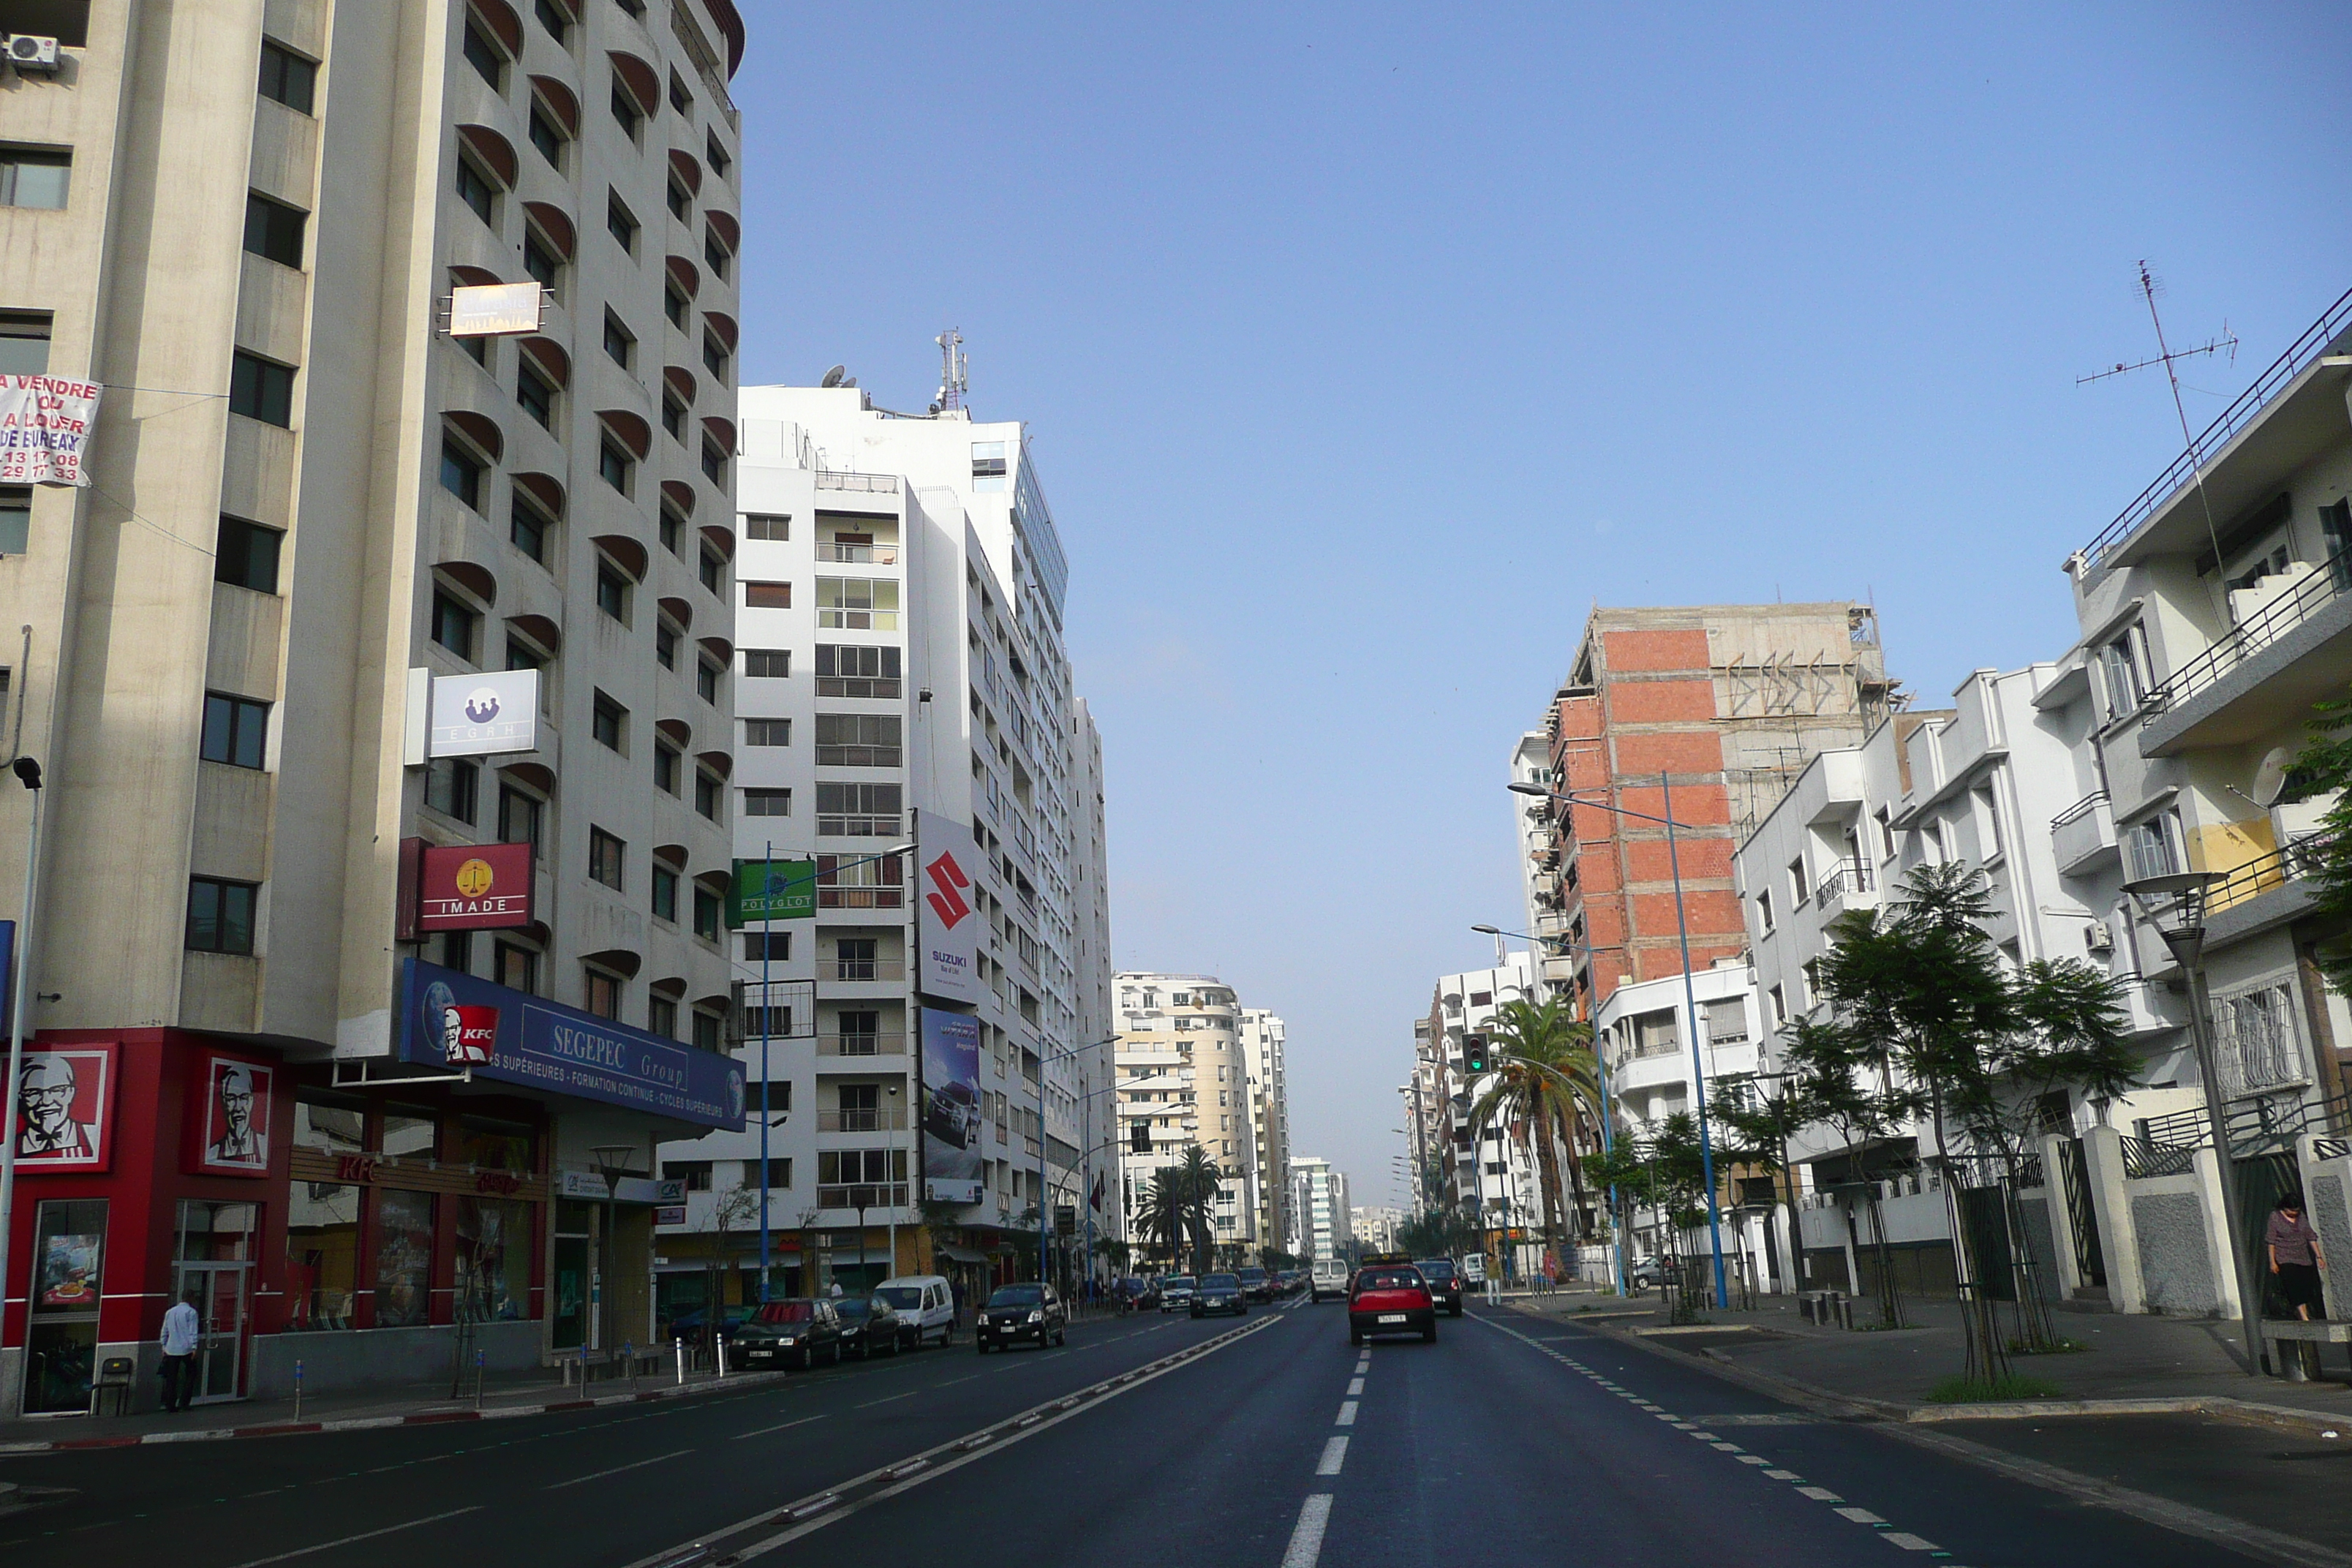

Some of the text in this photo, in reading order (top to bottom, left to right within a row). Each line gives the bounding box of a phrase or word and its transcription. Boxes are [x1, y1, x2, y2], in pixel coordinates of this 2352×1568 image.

[0, 374, 98, 401] A VENDRE
[37, 396, 65, 410] OU
[4, 413, 86, 434] A LOUER
[0, 430, 19, 448] DE
[2, 466, 24, 478] 29
[54, 467, 77, 480] 33
[450, 725, 514, 740] EGRH
[442, 900, 506, 914] IMADE
[741, 897, 811, 909] POLYGLOT
[932, 950, 967, 968] SUZUKI
[464, 1028, 493, 1040] KFC
[554, 1025, 683, 1090] SEGEPEC Group
[502, 1055, 565, 1082] SUPÉRIEURES
[571, 1071, 617, 1094] FORMATION
[618, 1082, 654, 1103] CONTINUE
[659, 1093, 685, 1109] CYCLES
[337, 1156, 379, 1183] KFC
